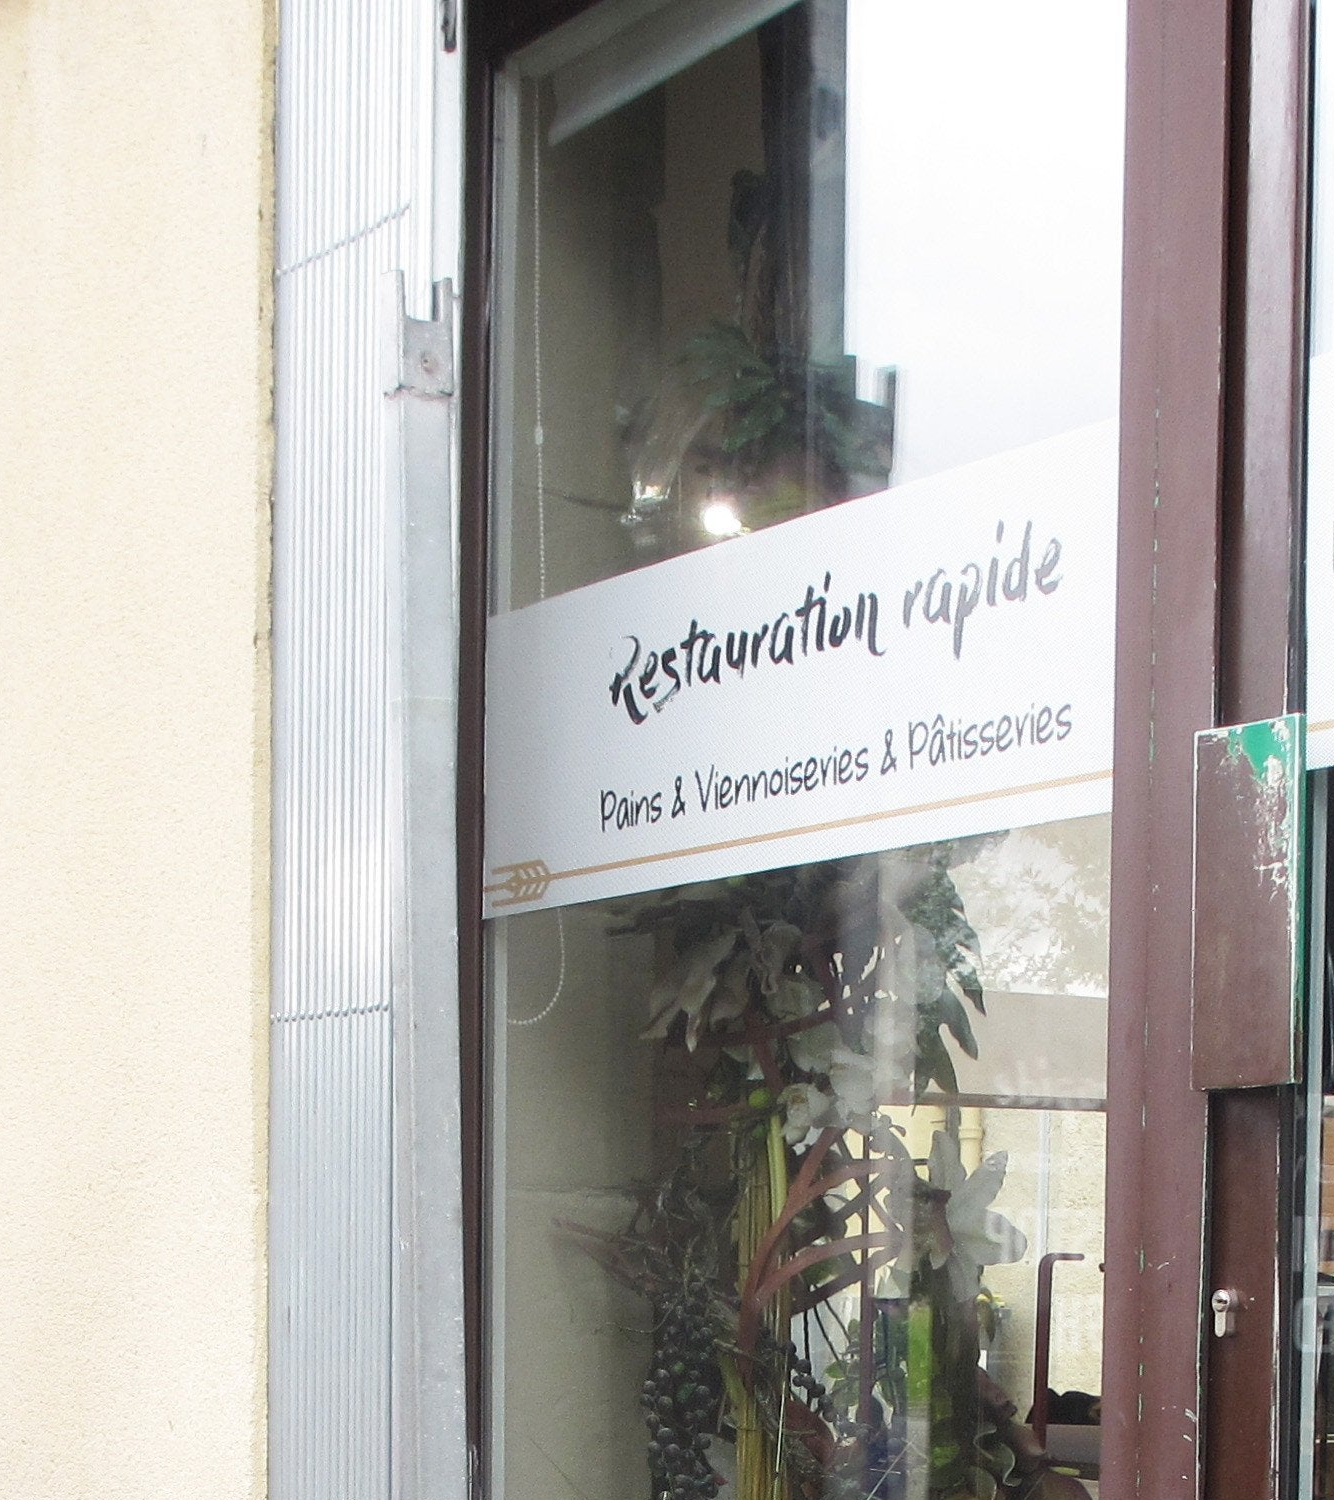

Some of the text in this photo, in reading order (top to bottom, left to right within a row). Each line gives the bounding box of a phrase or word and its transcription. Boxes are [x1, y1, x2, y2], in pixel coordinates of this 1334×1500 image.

[608, 519, 1064, 725] Restauration rapide
[600, 702, 1072, 833] Pains & Viennoiseries & Pâtisseries
